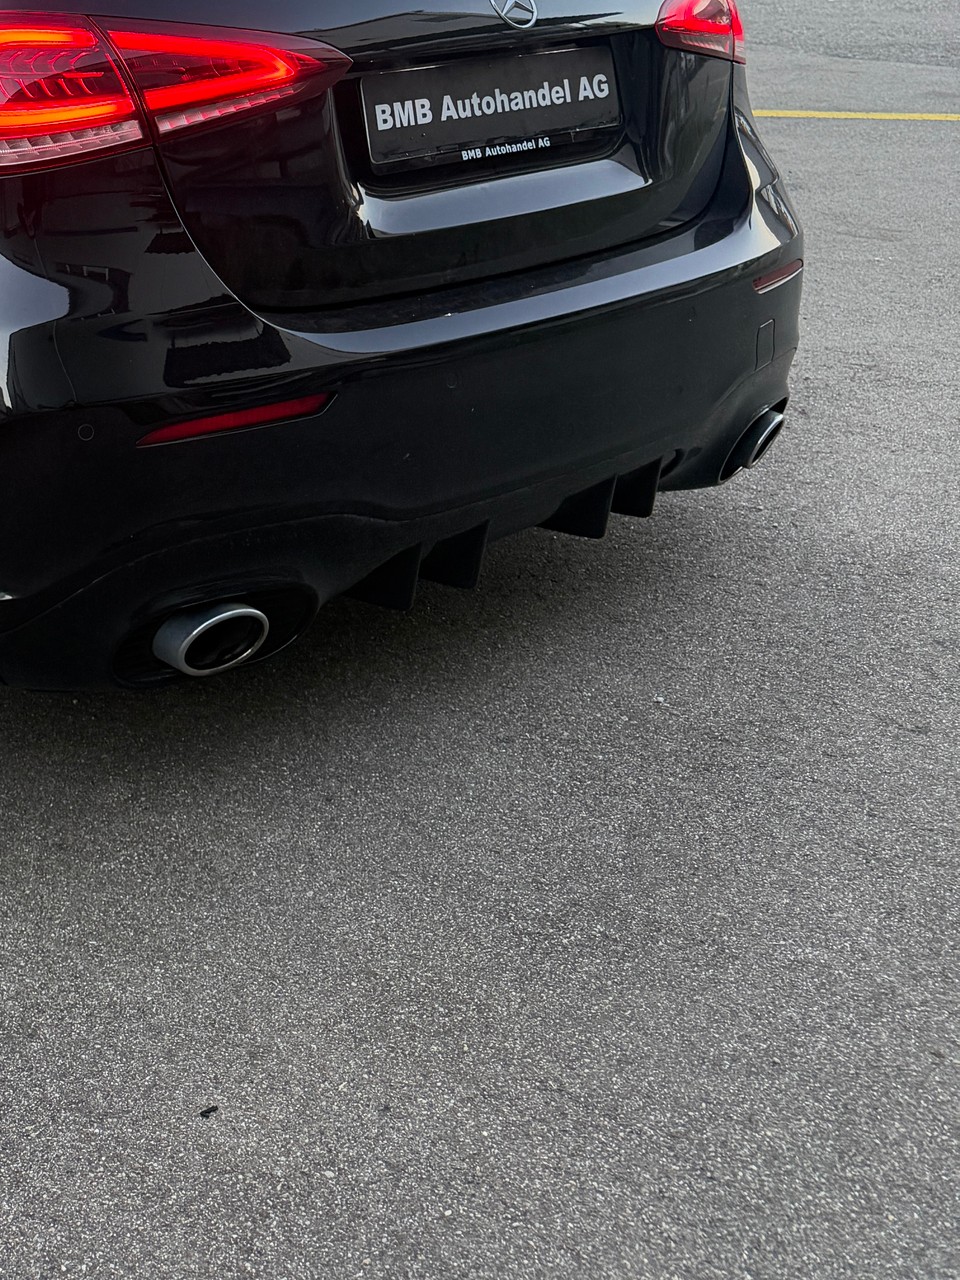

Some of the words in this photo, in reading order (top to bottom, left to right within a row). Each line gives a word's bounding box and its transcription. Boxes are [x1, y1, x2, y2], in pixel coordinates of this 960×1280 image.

[374, 98, 432, 131] BMB
[440, 79, 571, 122] Autohandel
[578, 73, 610, 101] AG
[461, 148, 481, 161] BMB
[485, 140, 535, 156] Autohandel
[538, 137, 551, 148] AG
